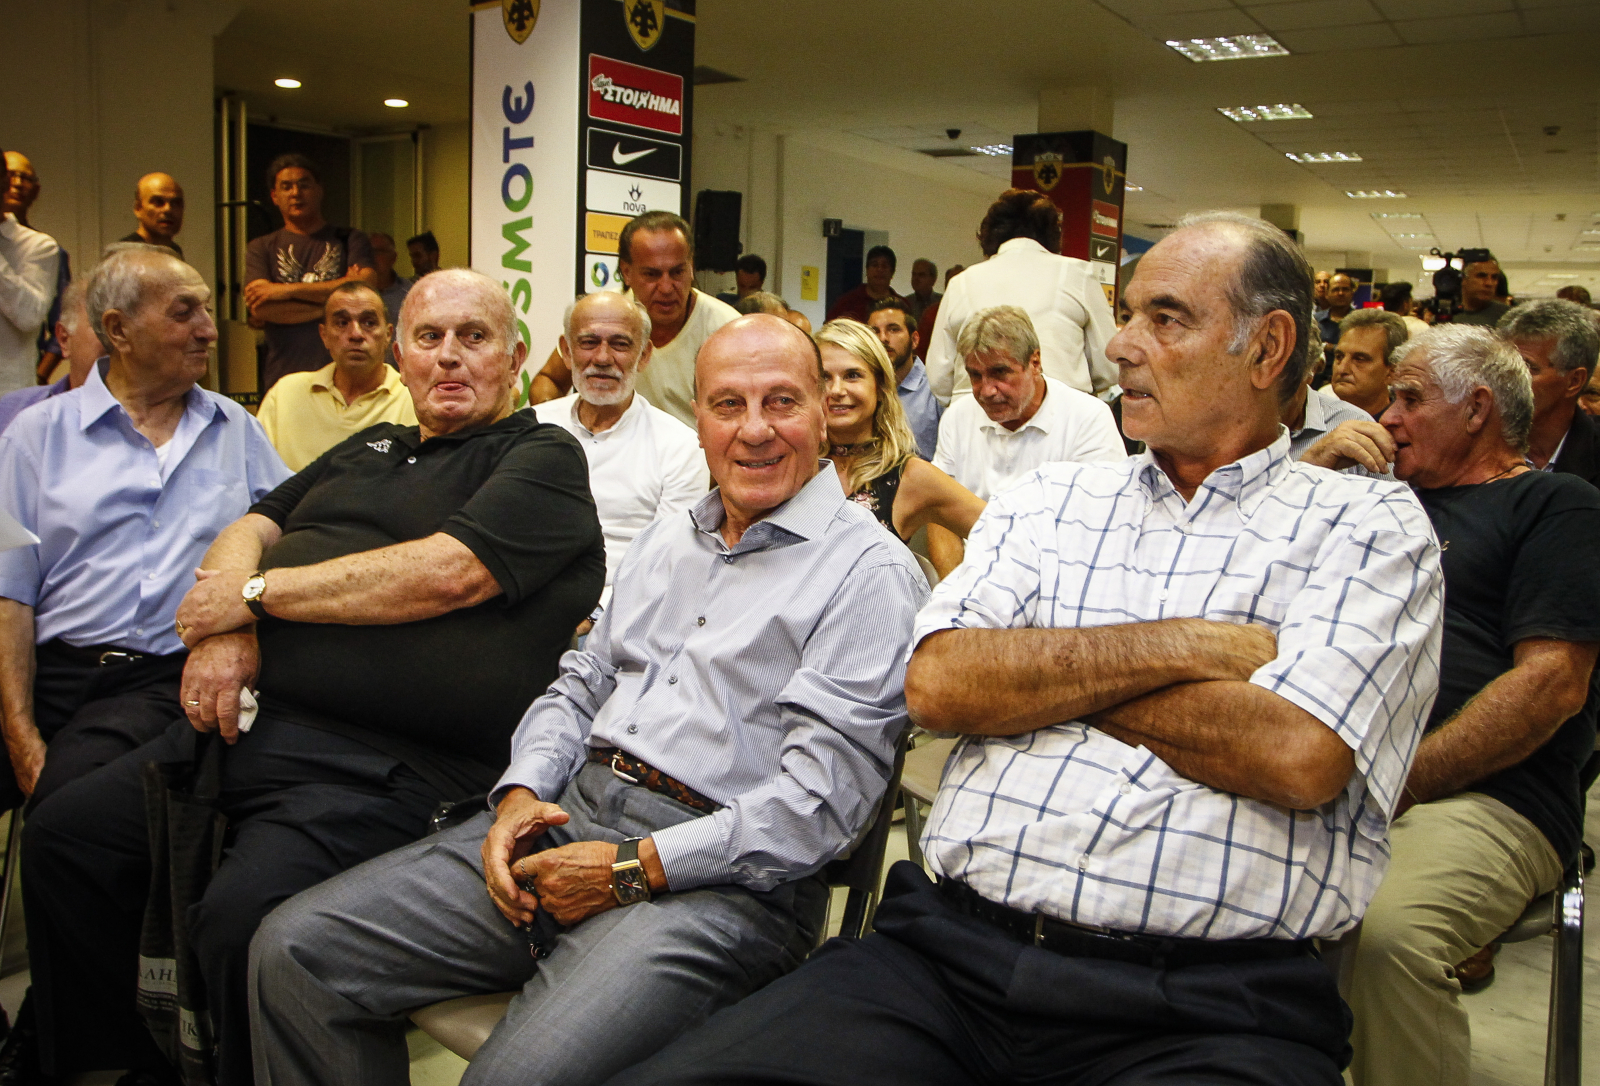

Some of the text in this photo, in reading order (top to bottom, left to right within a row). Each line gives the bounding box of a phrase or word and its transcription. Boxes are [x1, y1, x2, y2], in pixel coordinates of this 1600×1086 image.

[603, 85, 680, 116] ΣΤΟΙΧΗΜΑ
[623, 201, 647, 213] nova
[593, 230, 620, 240] ΤΡΑΠΕΖ
